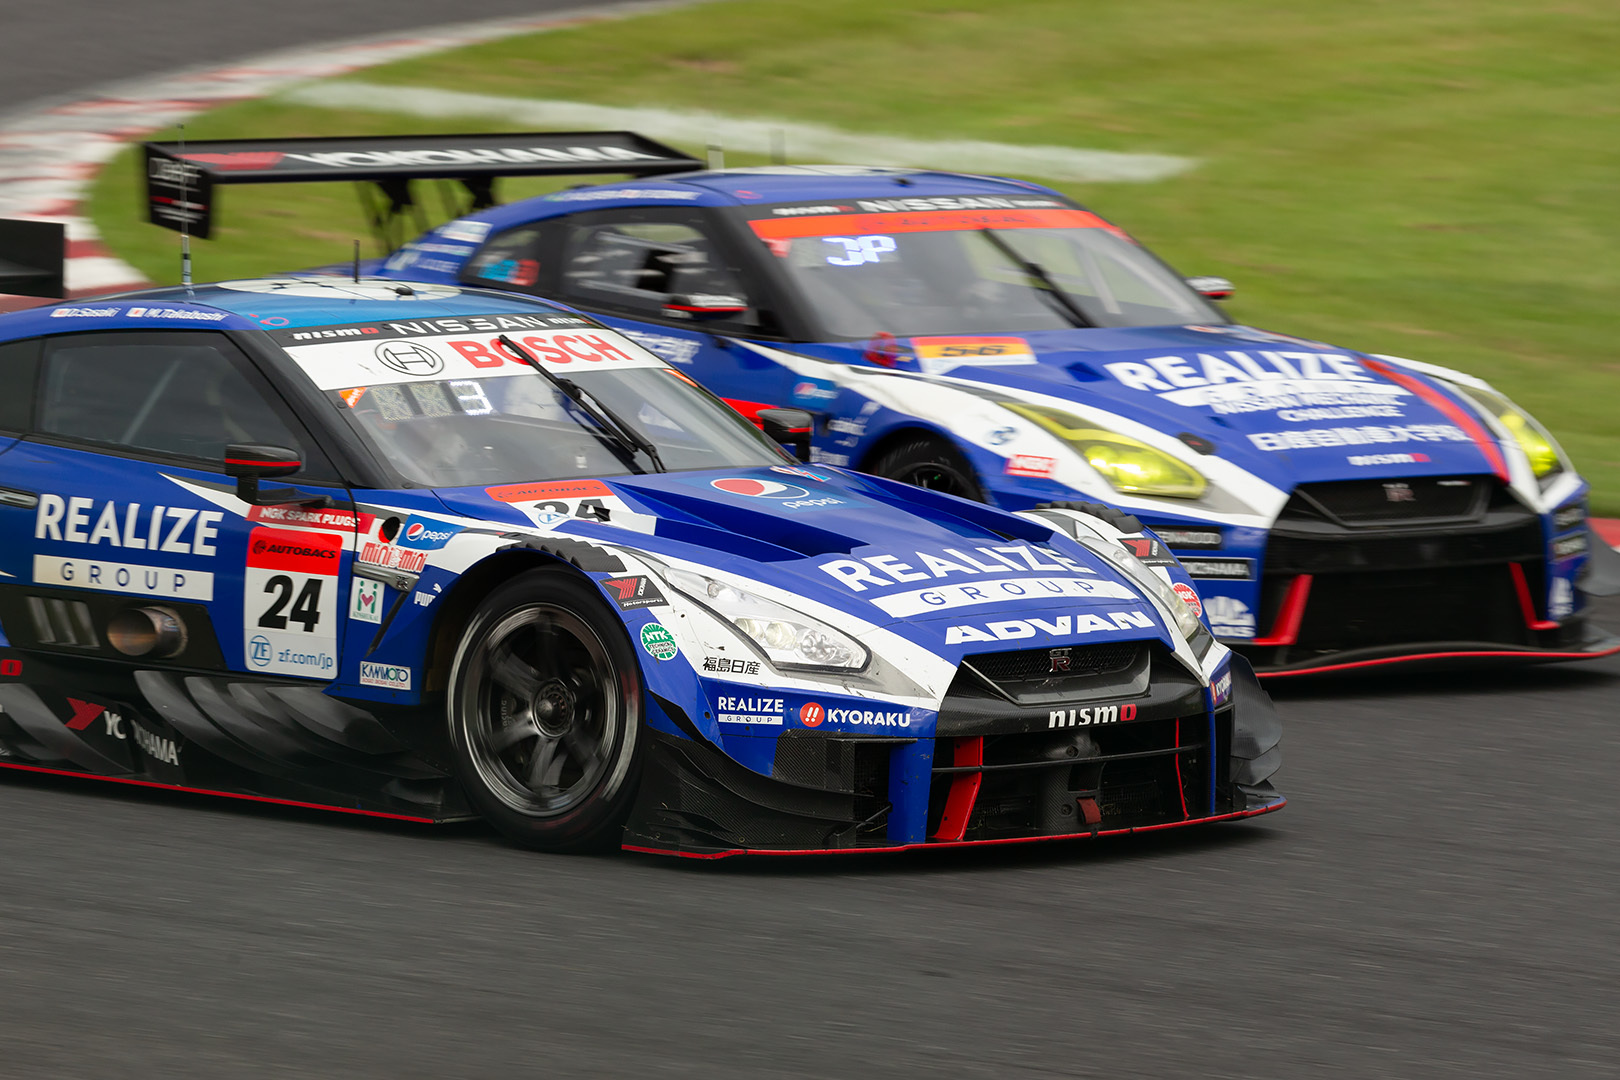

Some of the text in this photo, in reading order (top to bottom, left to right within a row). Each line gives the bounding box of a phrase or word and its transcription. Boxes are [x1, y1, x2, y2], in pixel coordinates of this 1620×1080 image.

[286, 146, 665, 167] YOKOHAMA
[856, 197, 1019, 212] NISSAN
[292, 327, 380, 340] nismo
[389, 316, 549, 335] NISSAN
[447, 334, 634, 369] BOSCH
[1103, 350, 1376, 392] REALIZE
[449, 381, 493, 416] 3
[34, 493, 224, 557] REALIZE
[260, 507, 361, 528] NGK SPARK PLUGS
[421, 531, 454, 542] pepsi
[266, 544, 337, 559] AUTOBACS
[61, 562, 186, 593] GROUP
[818, 544, 1097, 593] REALIZE
[258, 574, 323, 633] 24
[919, 579, 1095, 606] GROUP
[645, 631, 669, 642] NTK
[945, 610, 1156, 645] ADVAN
[278, 649, 334, 670] zf.com/jp
[702, 655, 761, 676] 福島日産
[718, 696, 784, 713] REALIZE
[727, 714, 773, 723] GROUP
[827, 708, 911, 728] KYORAKU
[1048, 703, 1137, 729] nismo
